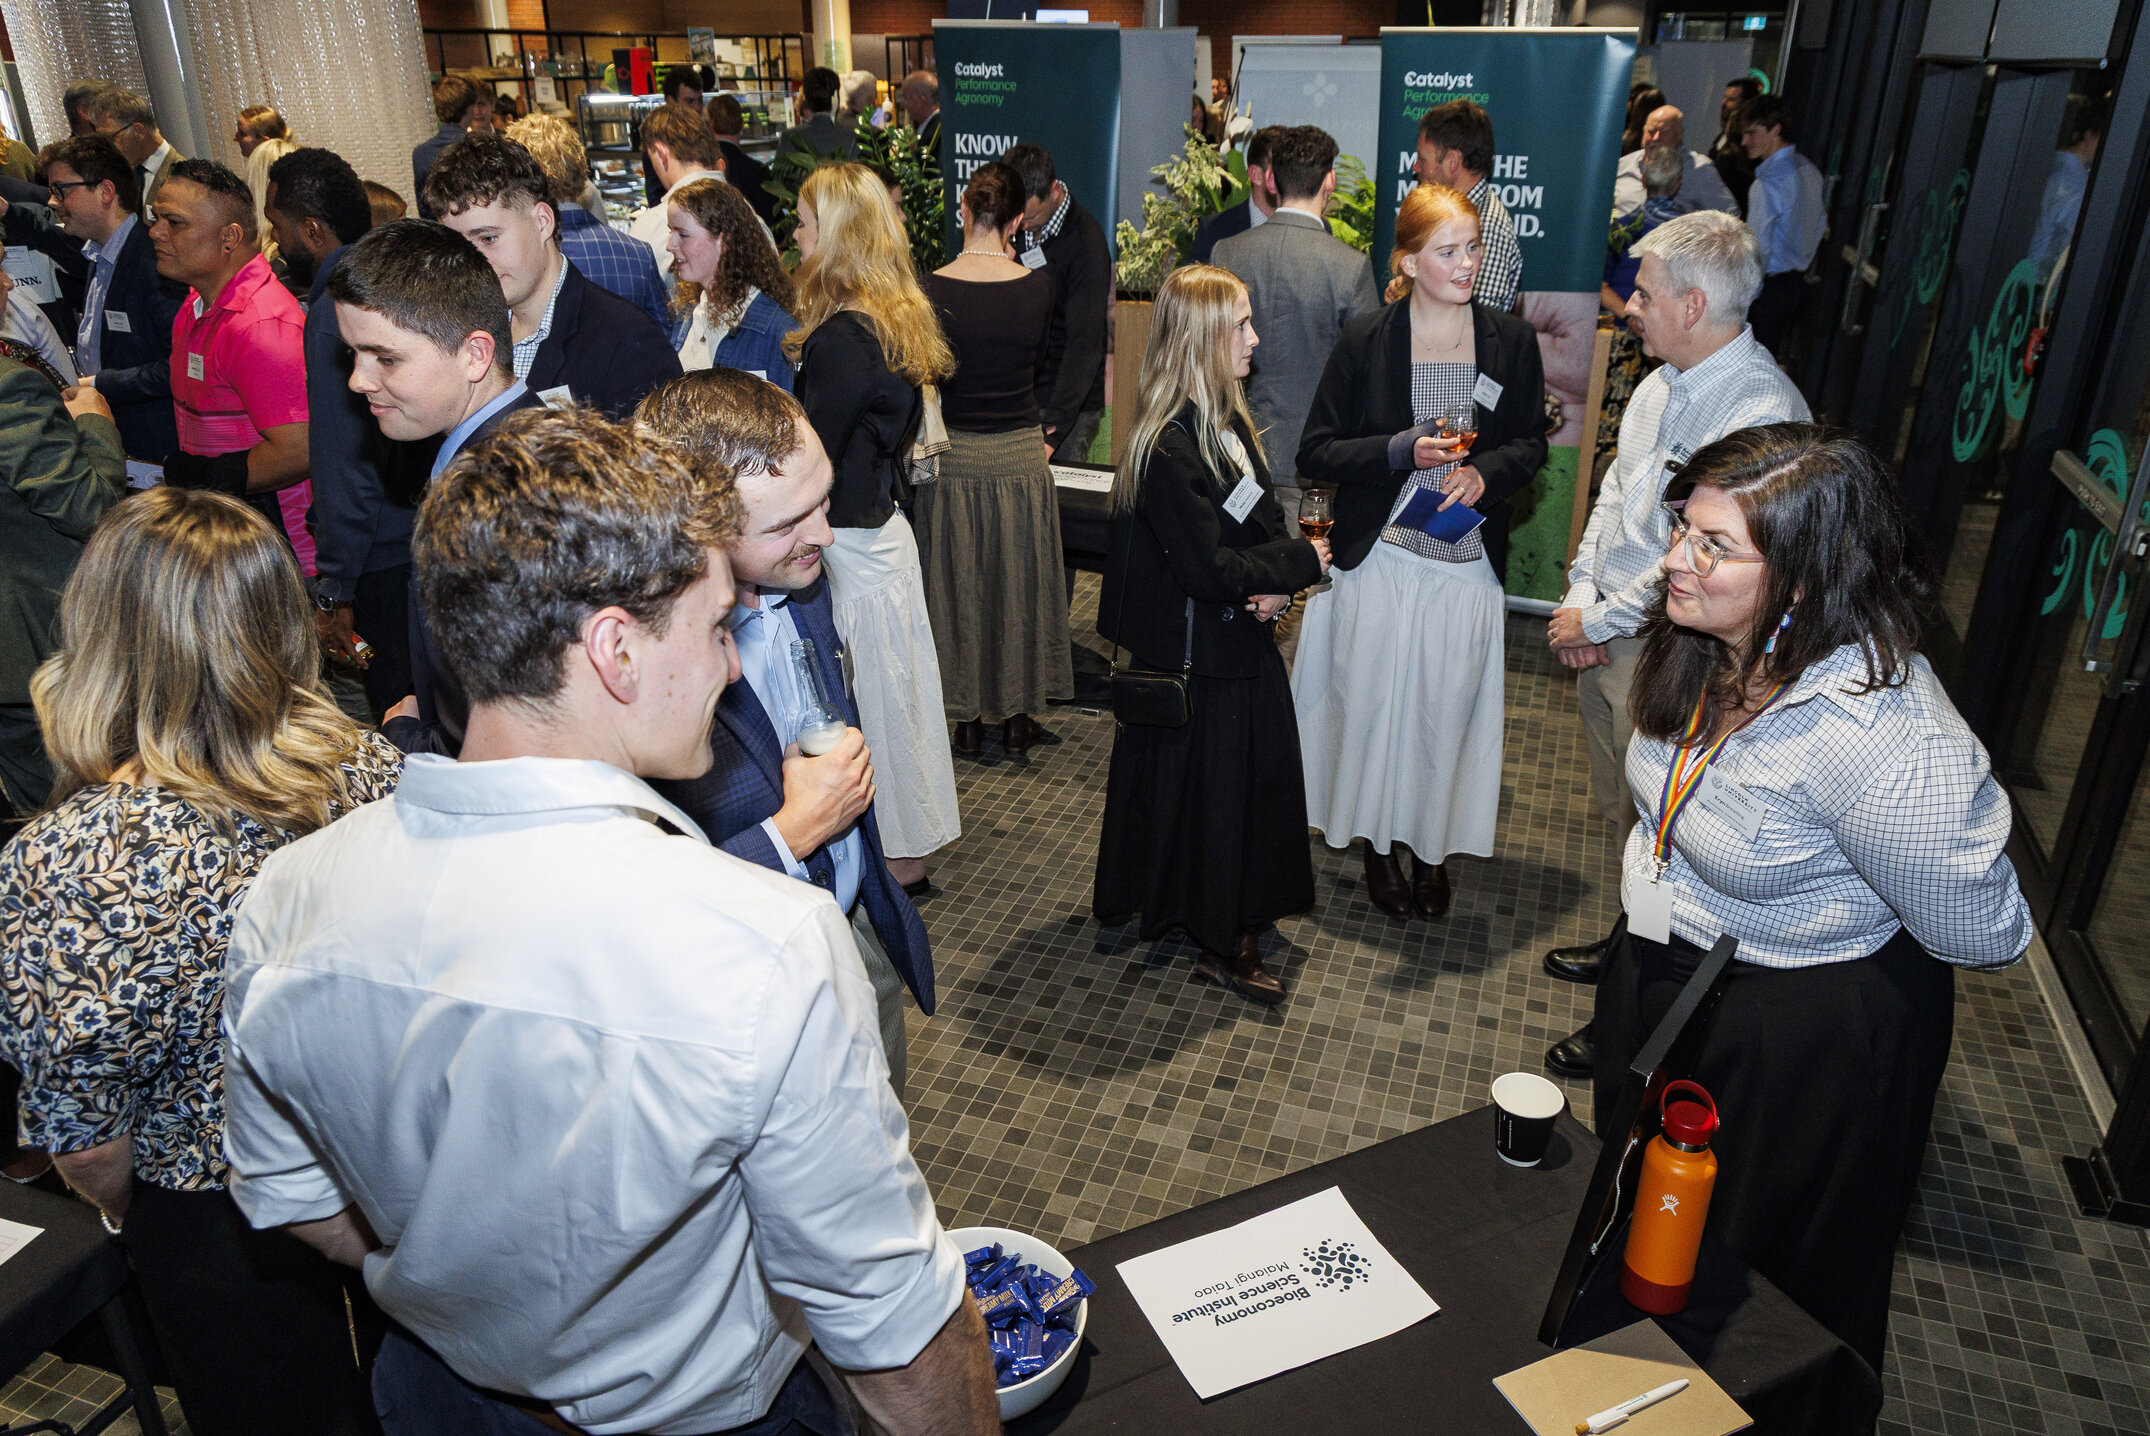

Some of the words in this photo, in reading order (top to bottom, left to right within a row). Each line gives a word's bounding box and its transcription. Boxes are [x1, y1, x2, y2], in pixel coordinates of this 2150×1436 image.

[955, 62, 1003, 79] Catalyst
[1404, 71, 1473, 91] Catalyst
[955, 78, 1017, 92] Performance
[955, 92, 1004, 107] Agronomy
[955, 133, 1018, 156] KNOW
[955, 159, 989, 179] TH
[1493, 154, 1528, 179] HE
[1488, 183, 1544, 209] OM
[1234, 1261, 1290, 1283] Maiangi
[1194, 1280, 1234, 1298] Taiao
[1238, 1274, 1301, 1300] Science
[1214, 1286, 1311, 1326] Bioeconomy
